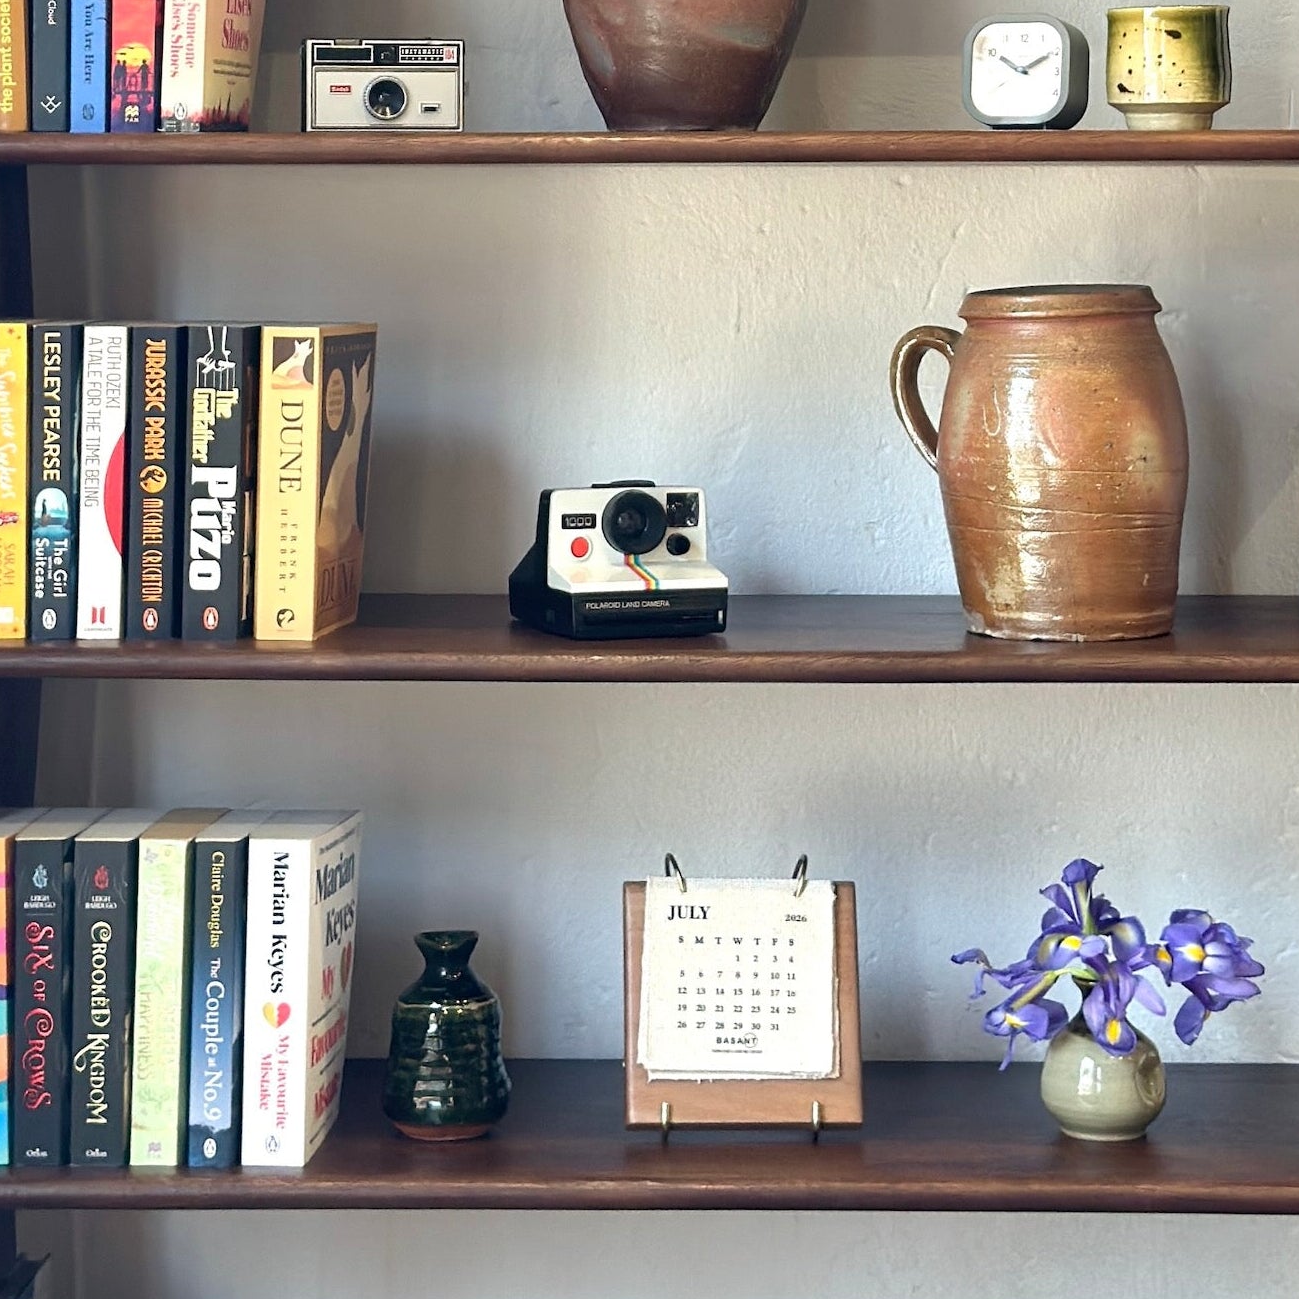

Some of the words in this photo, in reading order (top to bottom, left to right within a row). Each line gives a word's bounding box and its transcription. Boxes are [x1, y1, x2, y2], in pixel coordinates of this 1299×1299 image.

[83, 3, 94, 28] You
[185, 2, 201, 69] Someone
[84, 31, 94, 54] Are
[169, 33, 184, 79] Shoes
[988, 48, 997, 57] 10
[1020, 34, 1029, 42] 12
[83, 56, 94, 84] Here
[1054, 67, 1060, 76] 3
[88, 337, 103, 346] A
[106, 336, 122, 369] RUTH
[43, 331, 61, 400] LESLEY
[87, 347, 103, 379] TALE
[144, 338, 166, 412] JURASSIC
[87, 382, 101, 405] FOR
[105, 373, 120, 409] OZEKI
[215, 388, 239, 419] The
[86, 410, 101, 432] THE
[143, 417, 166, 460] PARK
[43, 405, 61, 481] PEARSE
[86, 437, 100, 465] TIME
[278, 399, 305, 494] DUNE
[84, 469, 99, 507] BEING
[141, 498, 163, 545] MICHAEL
[188, 464, 237, 591] Puzo
[220, 501, 237, 544] Mario
[34, 537, 50, 599] Suitcase
[52, 538, 68, 565] The
[277, 509, 289, 594] HERBERT
[288, 524, 299, 580] FRANK
[51, 569, 68, 598] Girl
[141, 550, 163, 602] CRICHTON
[211, 851, 226, 891] Claire
[271, 851, 290, 925] Marian
[208, 894, 224, 948] Douglas
[667, 905, 711, 920] JULY
[785, 913, 807, 922] 2026
[25, 921, 55, 974] SIX
[695, 936, 704, 944] M
[714, 936, 722, 945] T
[733, 937, 743, 945] W
[89, 920, 113, 1028] CROOKED
[209, 958, 221, 978] The
[267, 934, 288, 994] Keyes
[770, 972, 780, 980] 10
[696, 987, 706, 995] 13
[733, 988, 743, 996] 15
[770, 989, 780, 997] 17
[201, 981, 225, 1054] Couple
[696, 1021, 706, 1029] 27
[770, 1023, 779, 1031] 31
[22, 1008, 54, 1110] CROWS
[275, 1034, 290, 1055] My
[73, 1033, 111, 1124] KINGDOM
[203, 1070, 223, 1121] No.9
[259, 1053, 272, 1111] Mistake
[274, 1059, 289, 1129] Favourite
